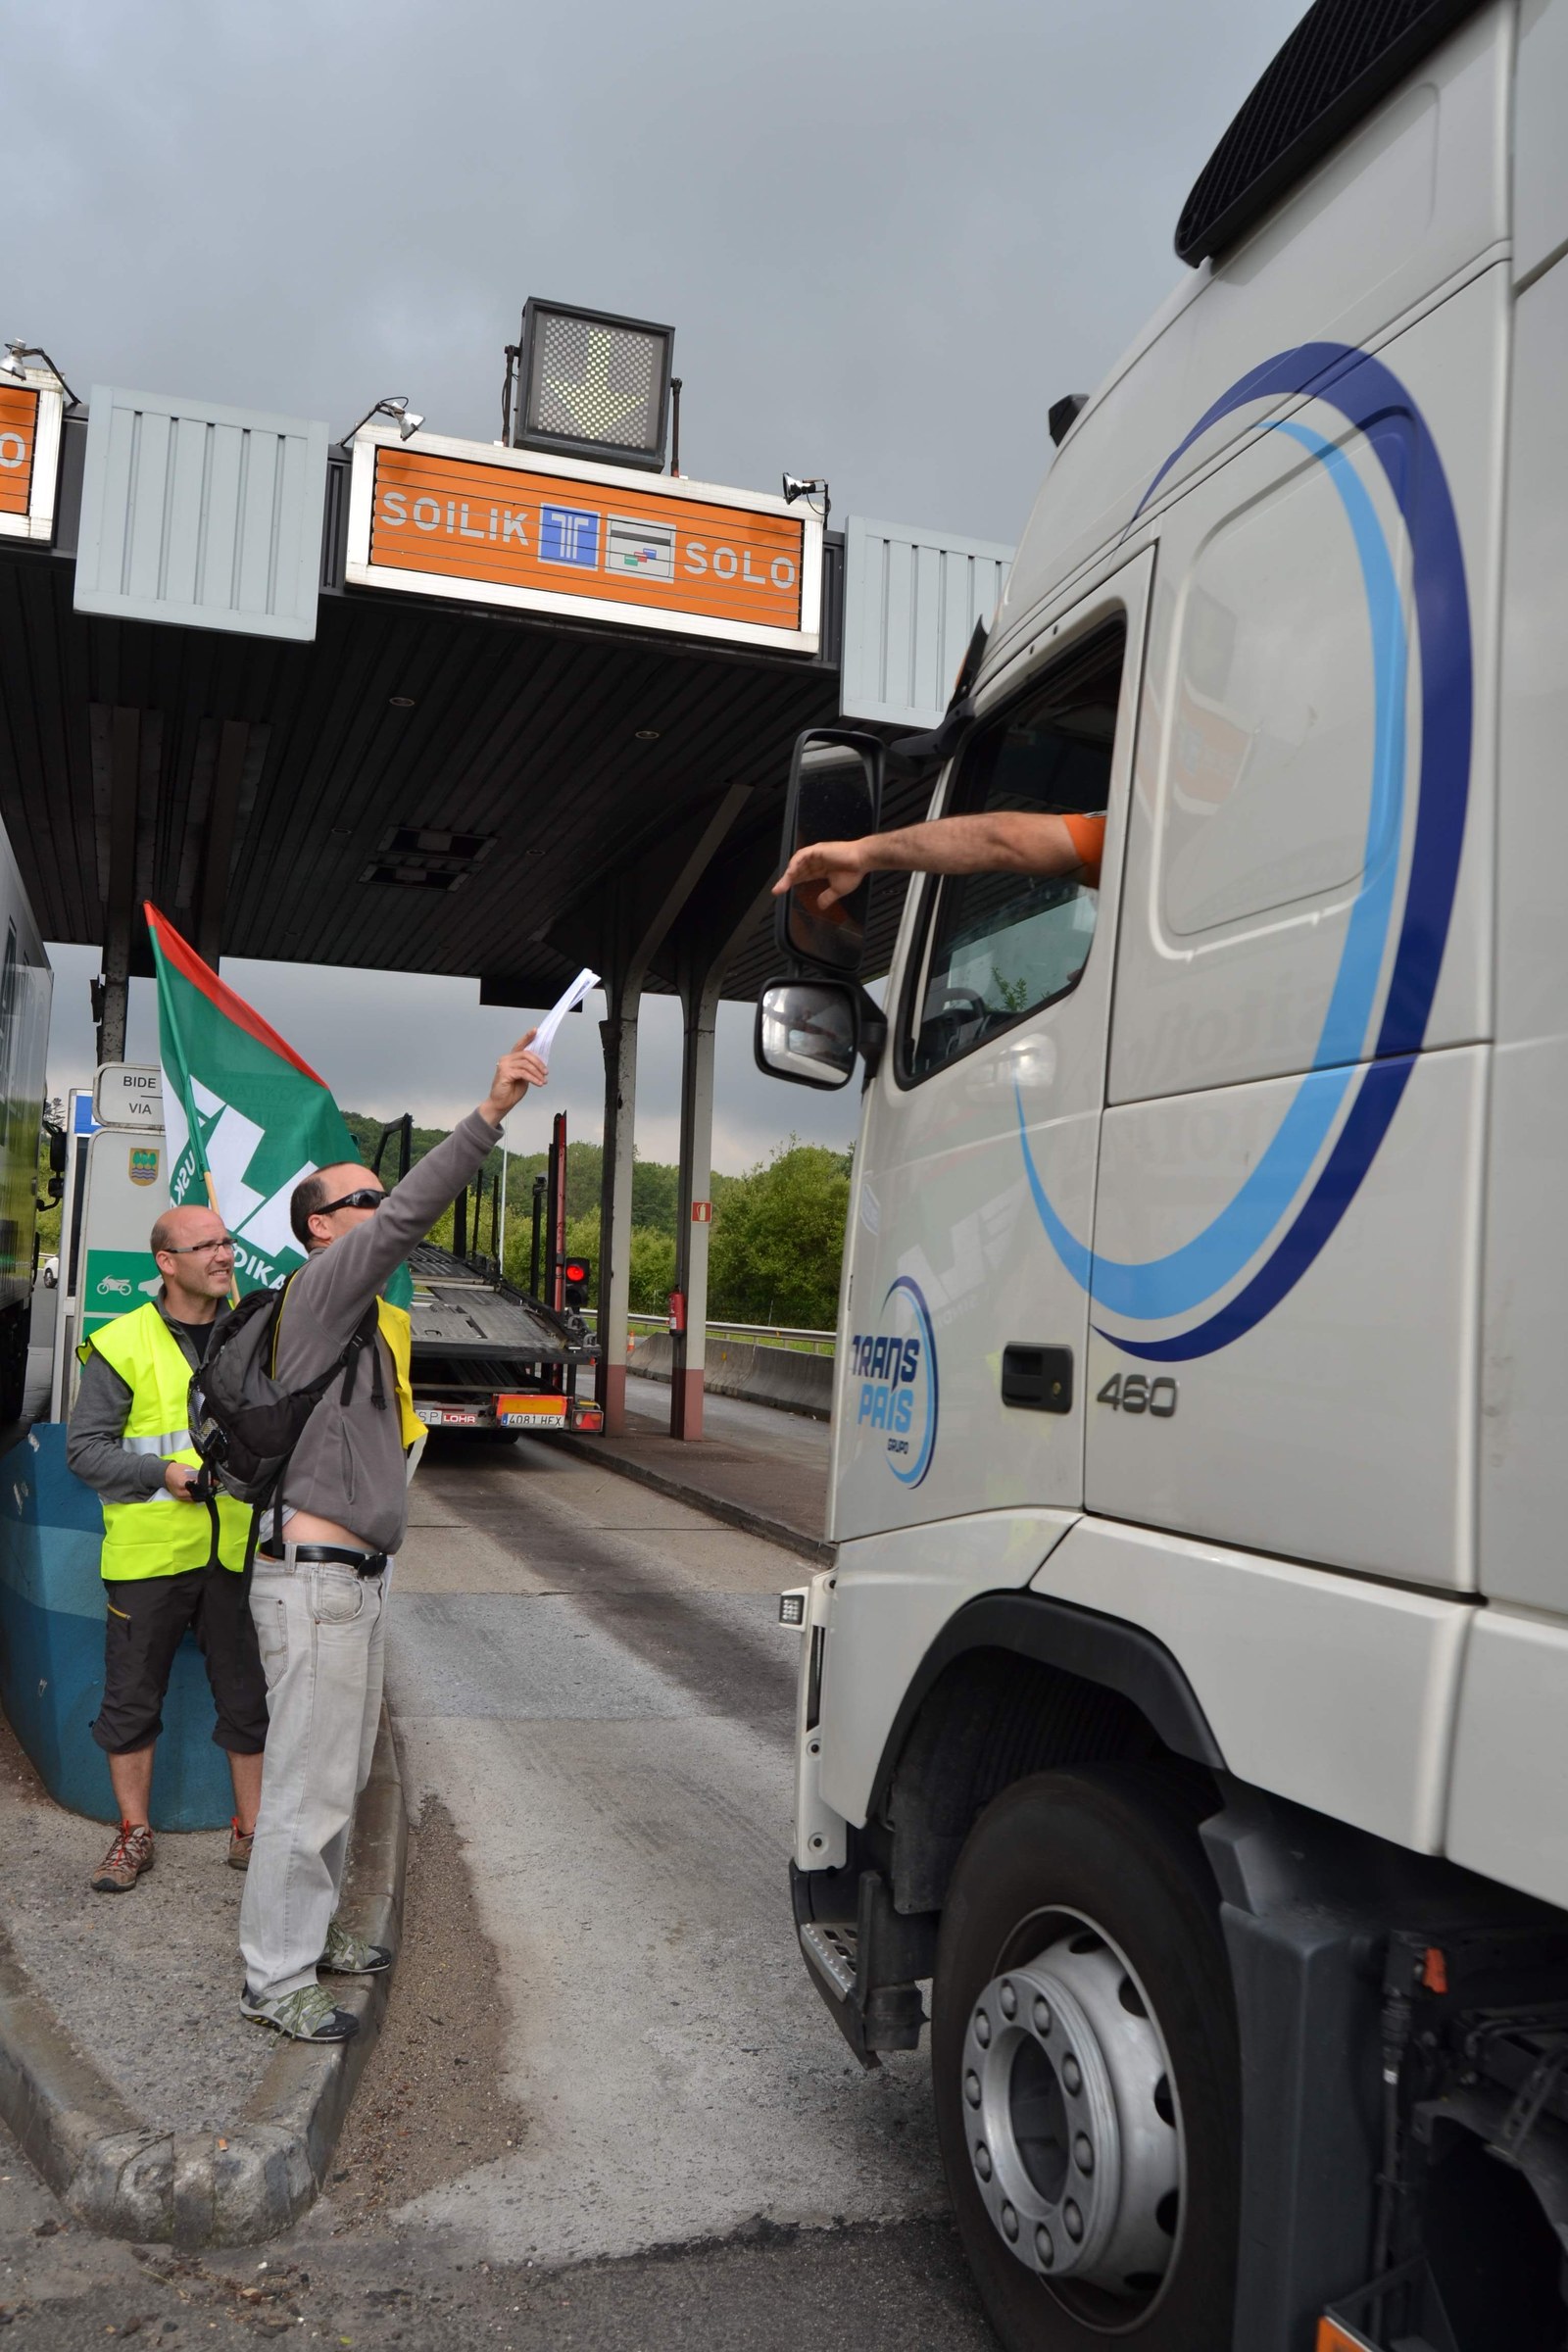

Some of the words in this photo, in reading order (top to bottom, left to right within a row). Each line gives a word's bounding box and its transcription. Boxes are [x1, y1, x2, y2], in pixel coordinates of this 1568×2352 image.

[380, 492, 529, 546] SOILIK
[683, 542, 796, 589] SOLO
[123, 1076, 157, 1089] BIDE
[128, 1102, 152, 1115] VIA
[1097, 1373, 1178, 1417] 460
[444, 1414, 476, 1424] LOHR
[887, 1438, 909, 1454] GRUPO
